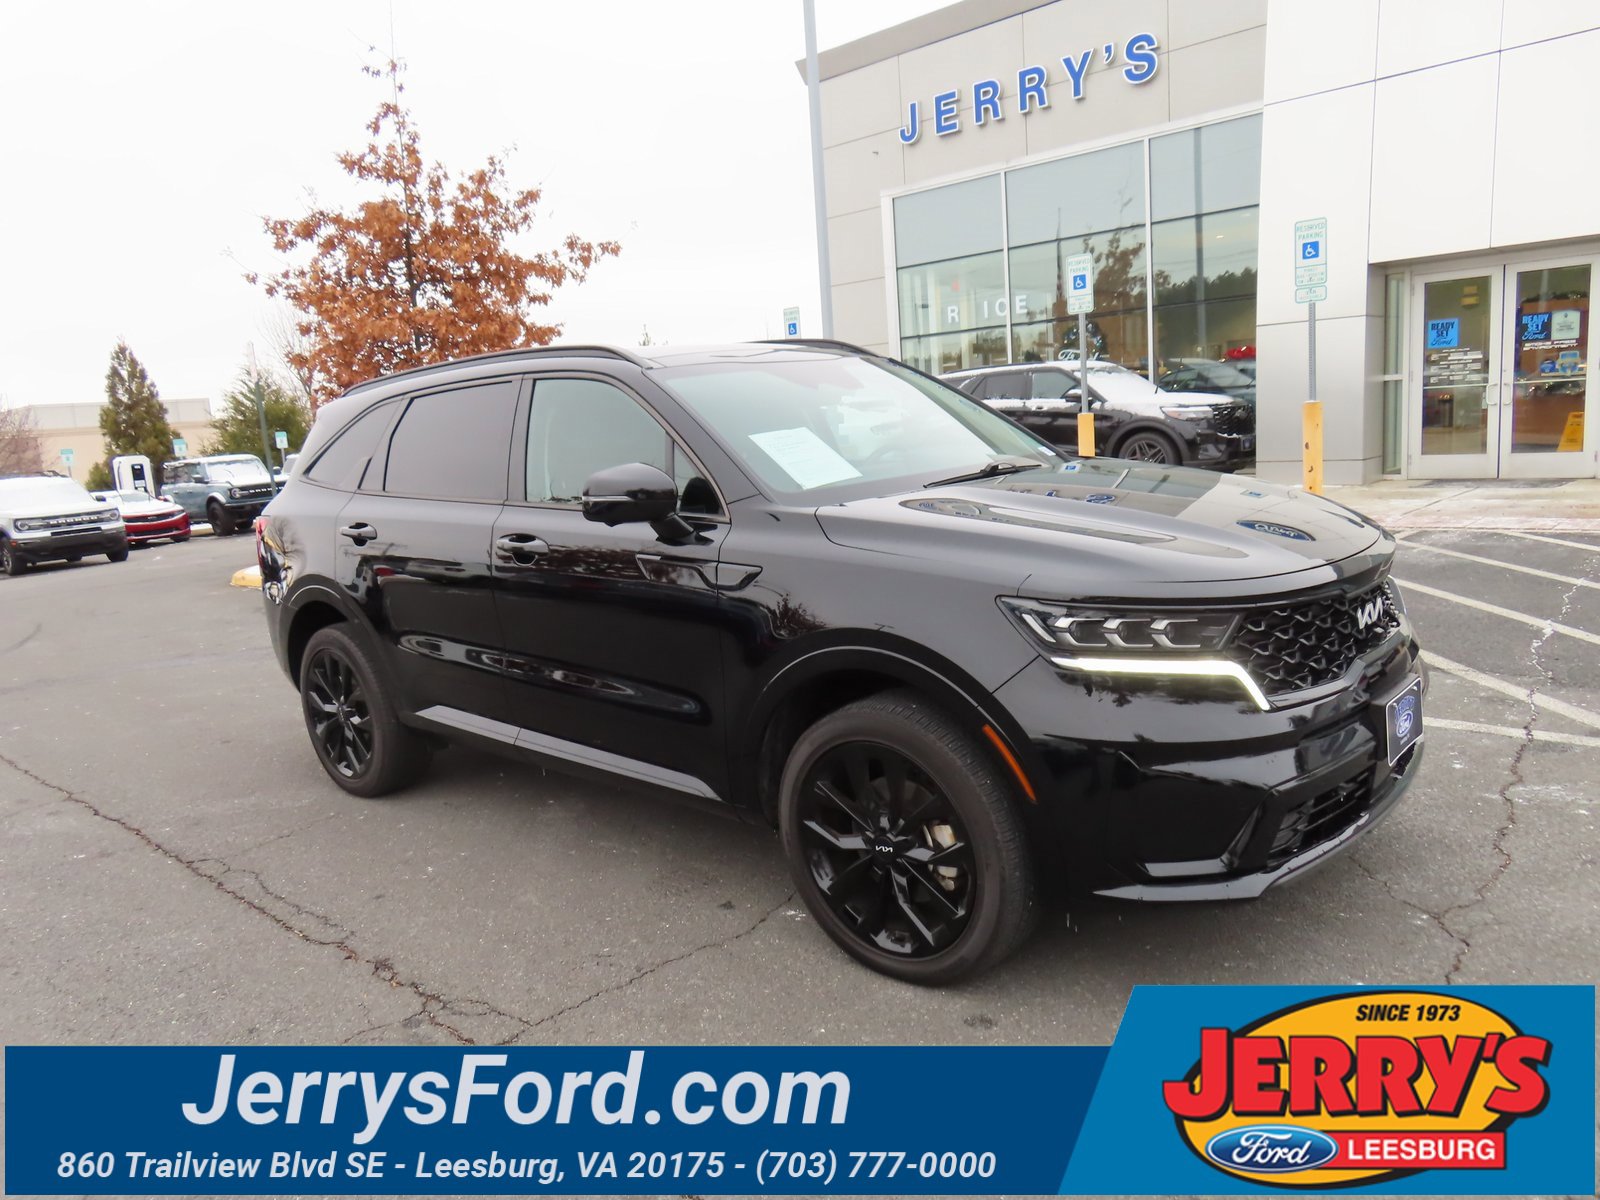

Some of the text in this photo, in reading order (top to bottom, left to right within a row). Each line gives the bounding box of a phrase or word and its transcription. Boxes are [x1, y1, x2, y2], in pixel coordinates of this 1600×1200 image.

[899, 32, 1159, 144] JERRY'S
[1431, 321, 1456, 331] READY
[1436, 329, 1450, 338] SET
